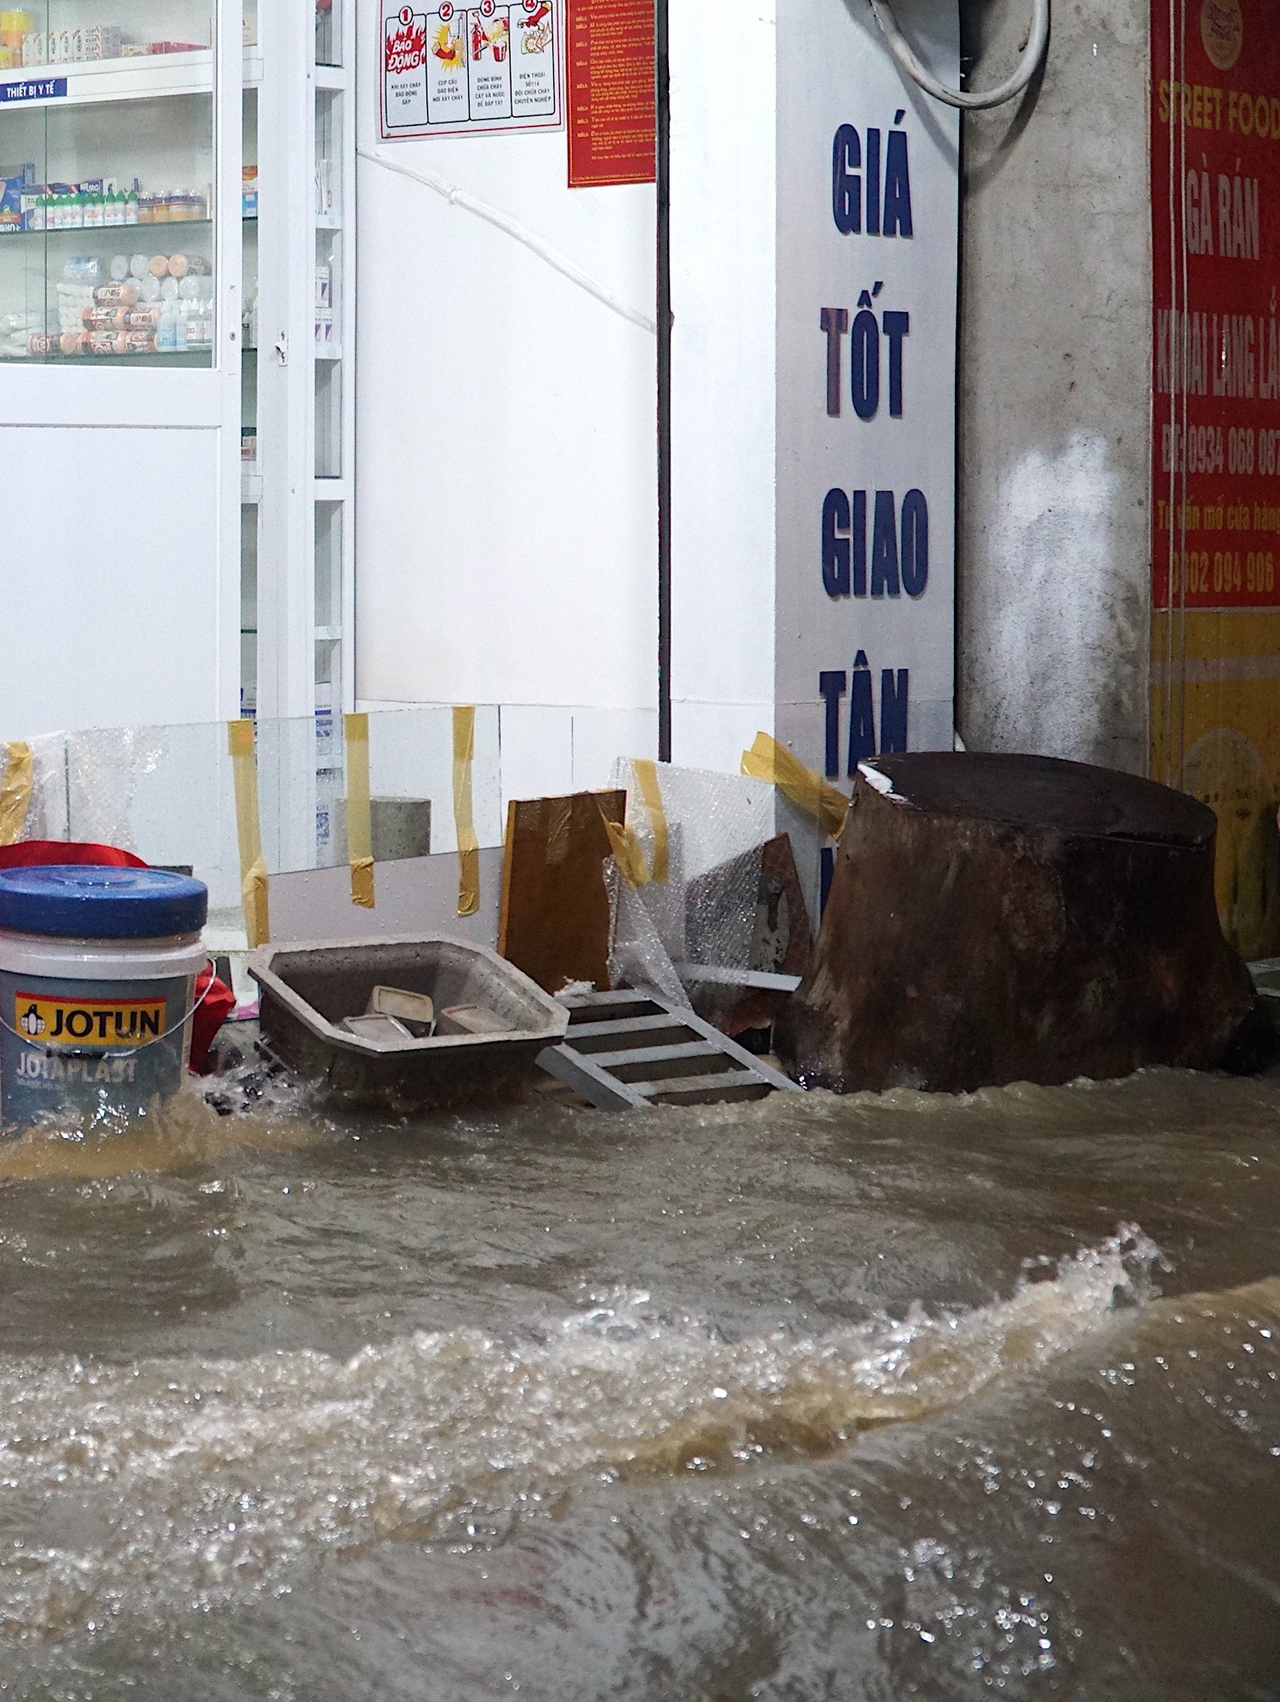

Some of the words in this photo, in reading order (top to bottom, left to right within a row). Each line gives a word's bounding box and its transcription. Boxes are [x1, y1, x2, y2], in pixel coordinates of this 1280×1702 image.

[402, 9, 409, 21] 1
[442, 4, 451, 17] 2
[483, 0, 492, 13] 3
[6, 82, 26, 98] THIẾT
[1158, 79, 1223, 131] STREET
[1228, 88, 1280, 140] FOOD
[832, 108, 914, 238] GIÁ
[1186, 152, 1214, 256] GÀ
[1218, 157, 1260, 261] RÁN
[820, 280, 910, 422] TỐT
[1212, 313, 1255, 399] LANG
[821, 487, 929, 600] GIAO
[819, 649, 909, 778] TÂN
[49, 1009, 160, 1038] JOTUN
